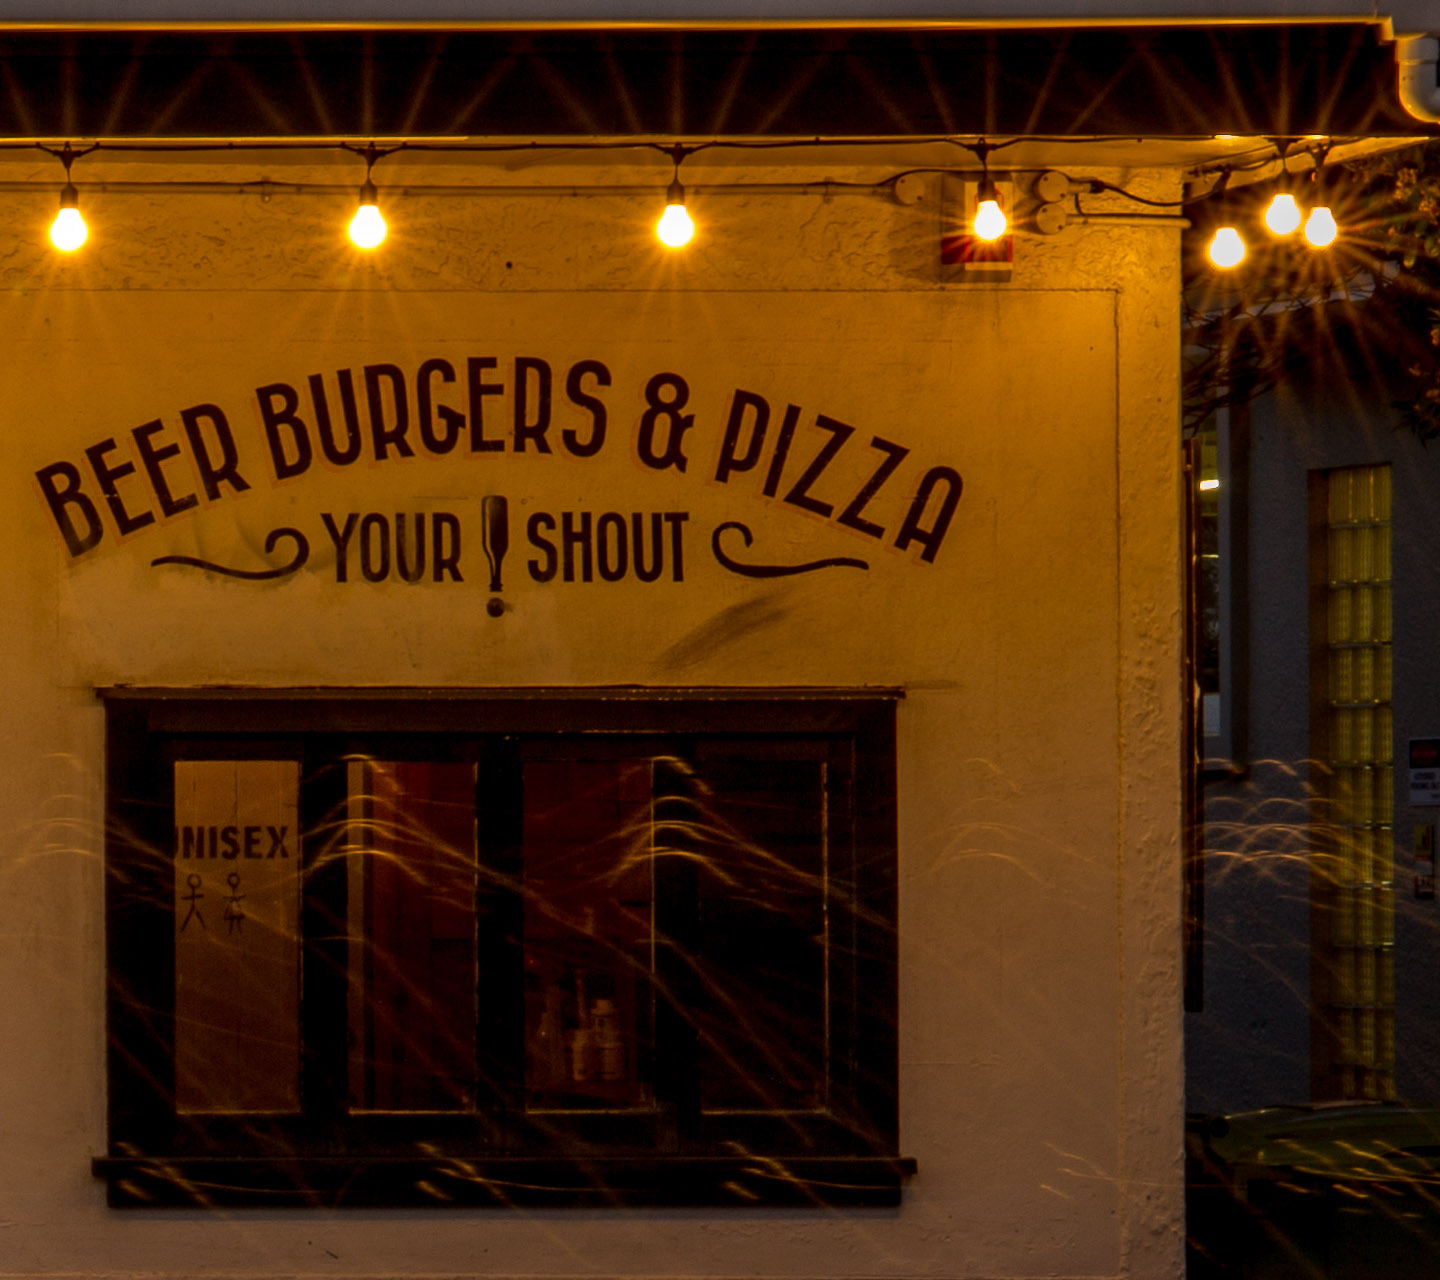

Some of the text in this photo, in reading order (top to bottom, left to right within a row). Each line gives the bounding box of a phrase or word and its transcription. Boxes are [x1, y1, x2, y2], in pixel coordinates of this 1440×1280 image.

[35, 356, 964, 564] BEER BURGERS & PIZZA
[320, 511, 689, 583] YOUR SHOUT
[174, 825, 289, 860] NISEX
